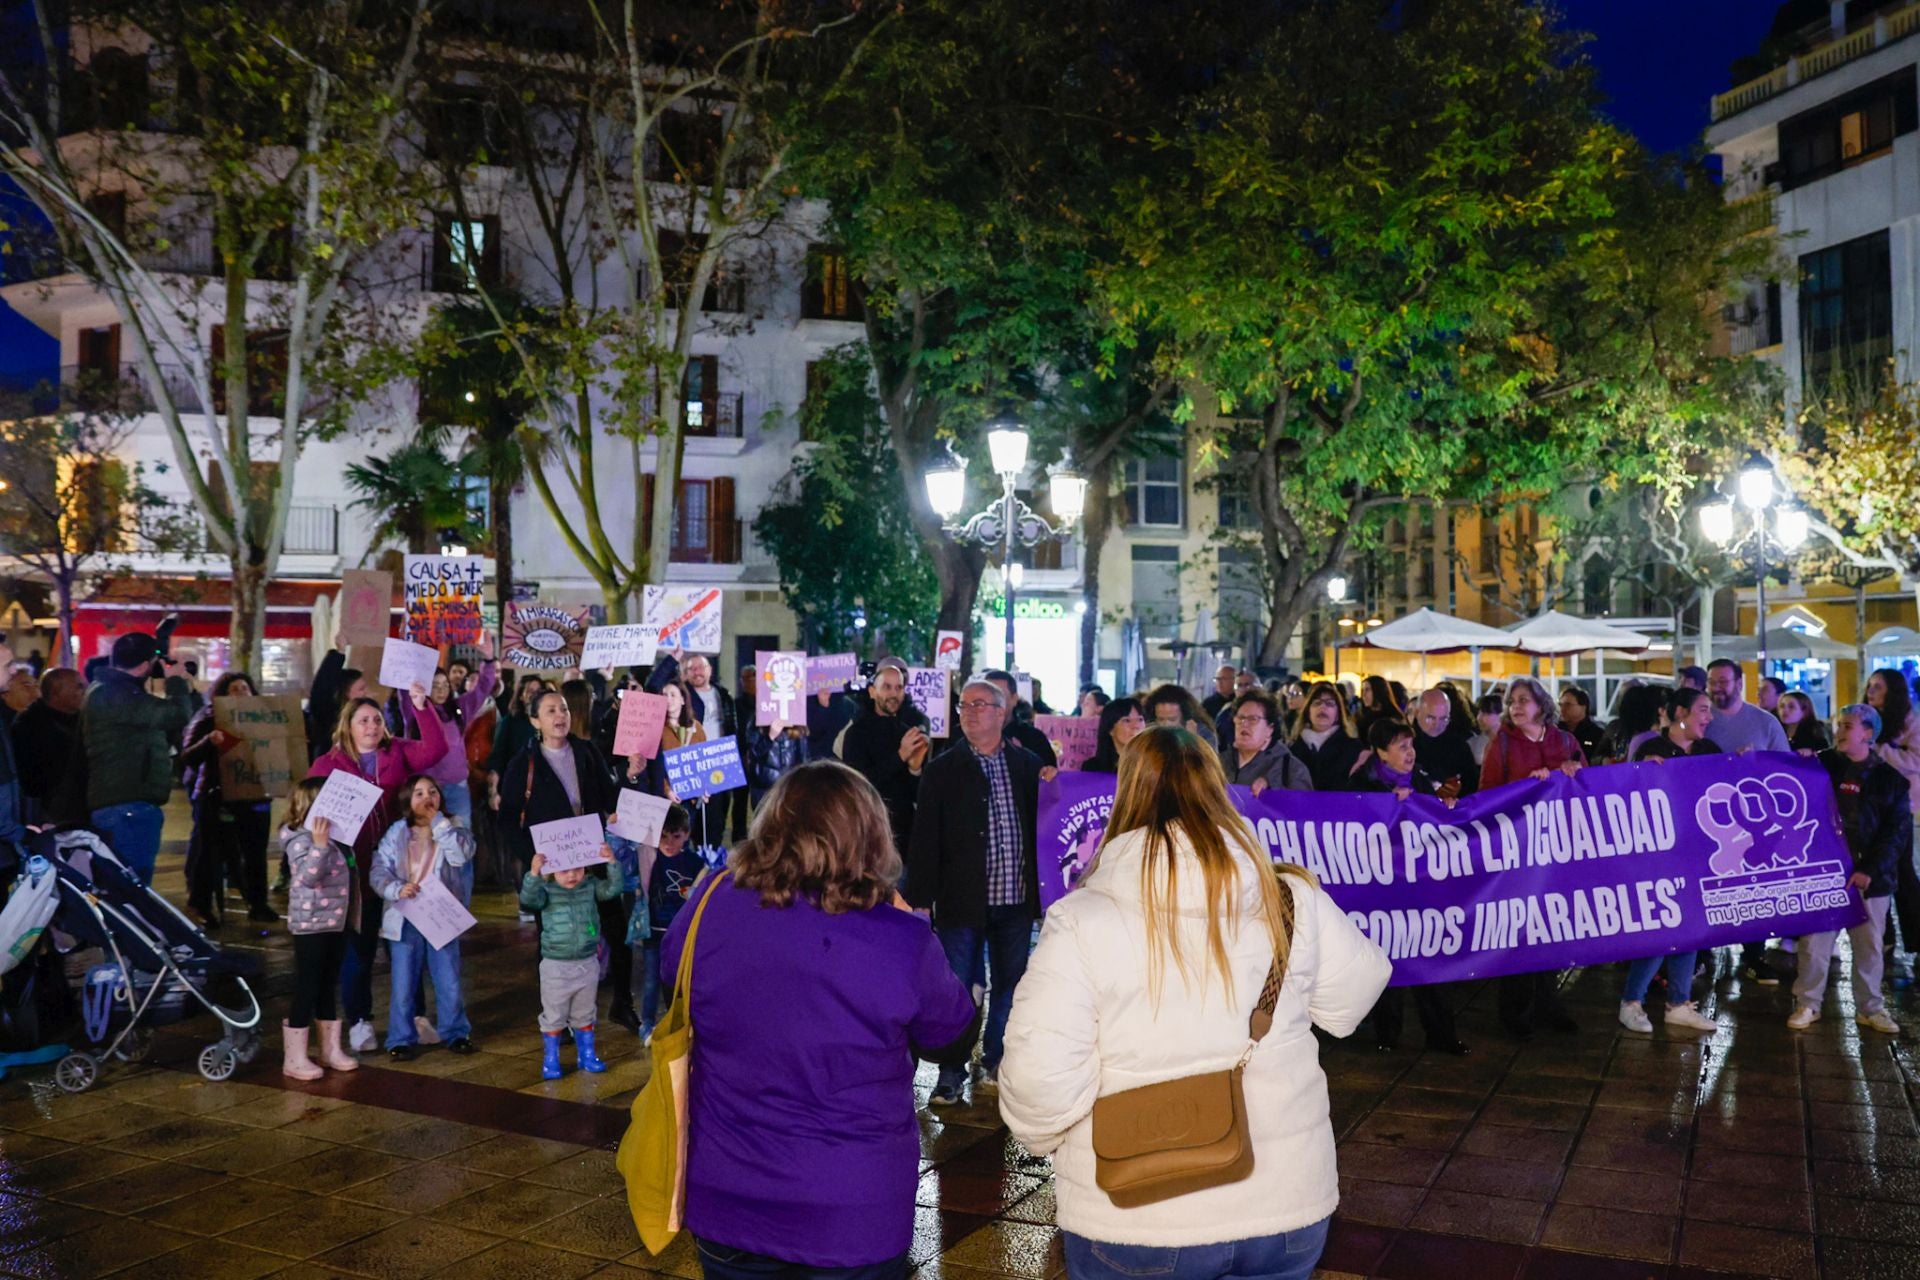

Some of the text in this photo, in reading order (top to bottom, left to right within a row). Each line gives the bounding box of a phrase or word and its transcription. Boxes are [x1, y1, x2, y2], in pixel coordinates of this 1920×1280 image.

[409, 561, 462, 580] CAUSA
[406, 581, 483, 598] MIEDO TENER
[407, 601, 429, 615] UNA
[760, 701, 778, 713] 8M
[666, 755, 679, 766] ME
[683, 763, 694, 777] EL
[1069, 795, 1114, 817] JUNTAS
[1058, 806, 1112, 845] IMPAR
[539, 827, 586, 845] LUCHAR
[1400, 820, 1475, 883] POR
[1470, 812, 1521, 873] LA
[1522, 788, 1677, 867] IGUALDAD
[1703, 876, 1845, 904] Federación de organizaciones de
[1707, 889, 1849, 925] mujeres de Lorca
